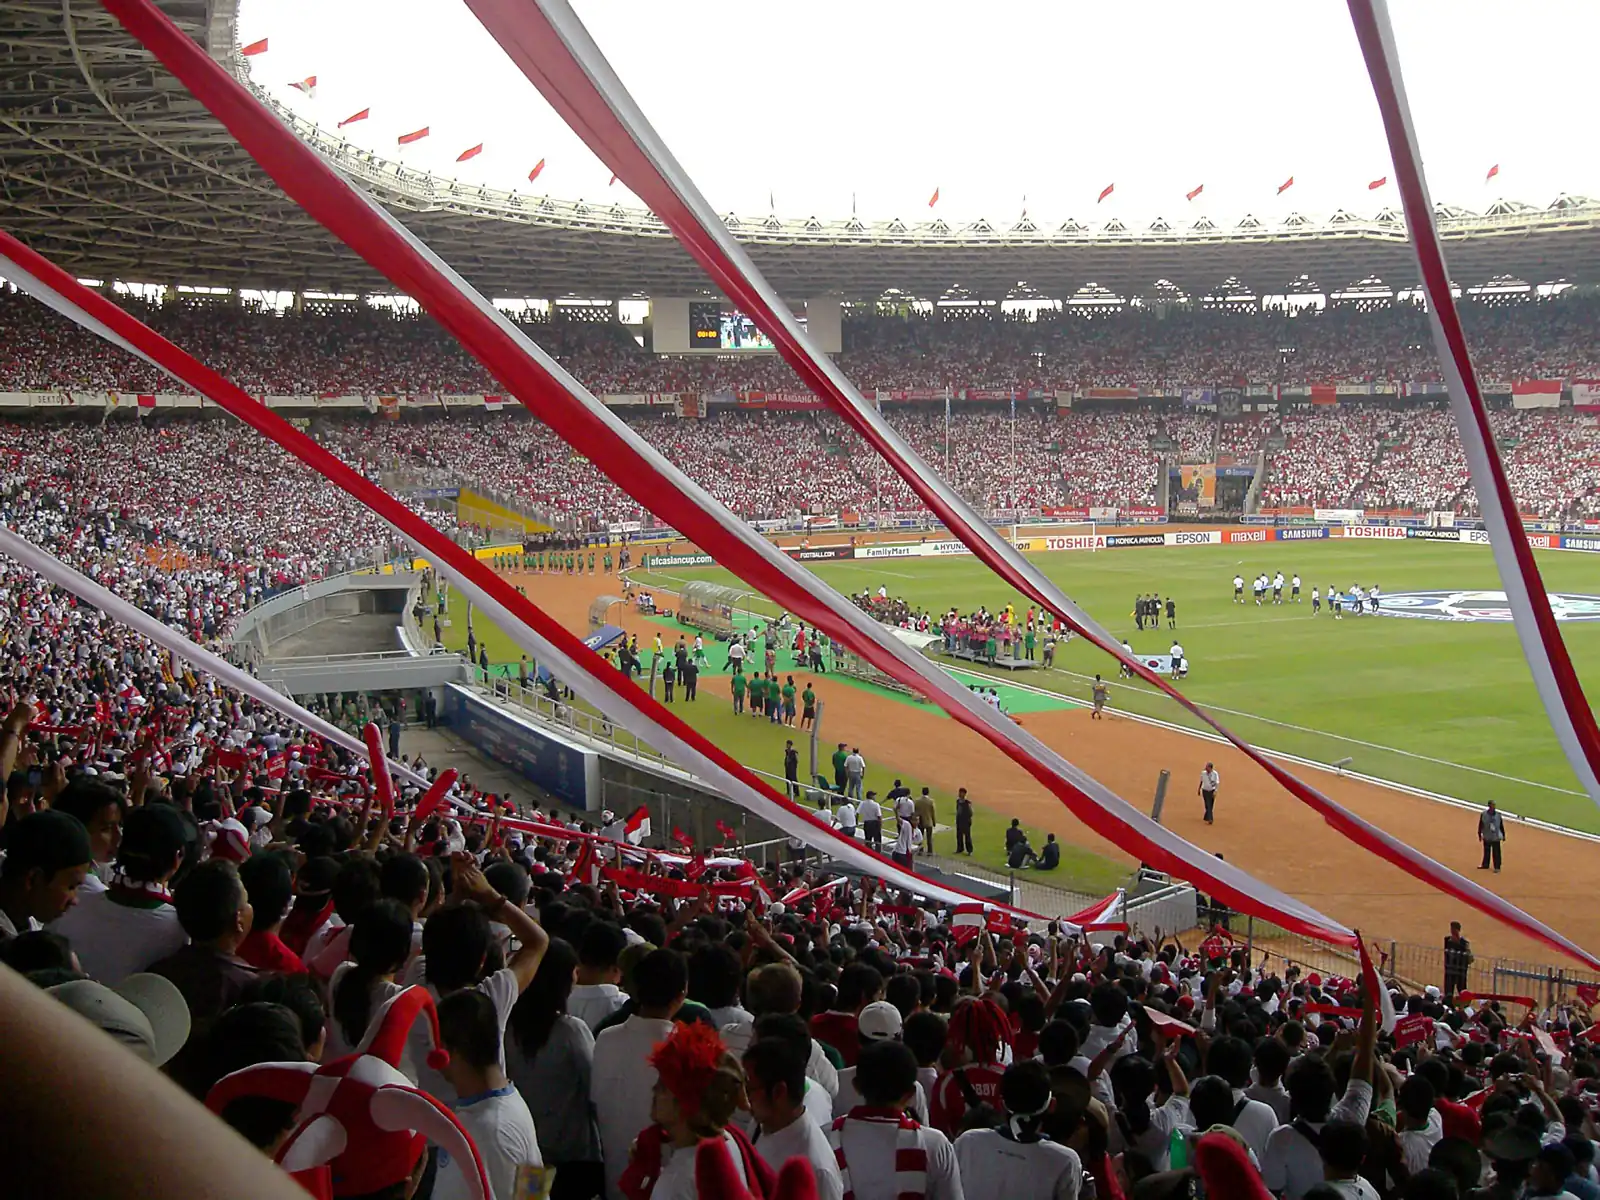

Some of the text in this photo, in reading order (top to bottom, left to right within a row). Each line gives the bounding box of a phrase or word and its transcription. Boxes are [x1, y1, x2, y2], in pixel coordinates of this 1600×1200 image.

[1230, 530, 1266, 542] maxell
[1282, 528, 1324, 539] SAMSUNG
[1345, 527, 1405, 537] TOSHIBA
[1470, 531, 1488, 542] EPS
[1049, 537, 1105, 549] TOSHIBA
[1175, 533, 1210, 544] EPSON
[1527, 535, 1550, 547] axell
[1565, 538, 1600, 550] SAMSUN
[866, 547, 910, 557] FamilyMart
[651, 555, 712, 566] afcasiancup.com
